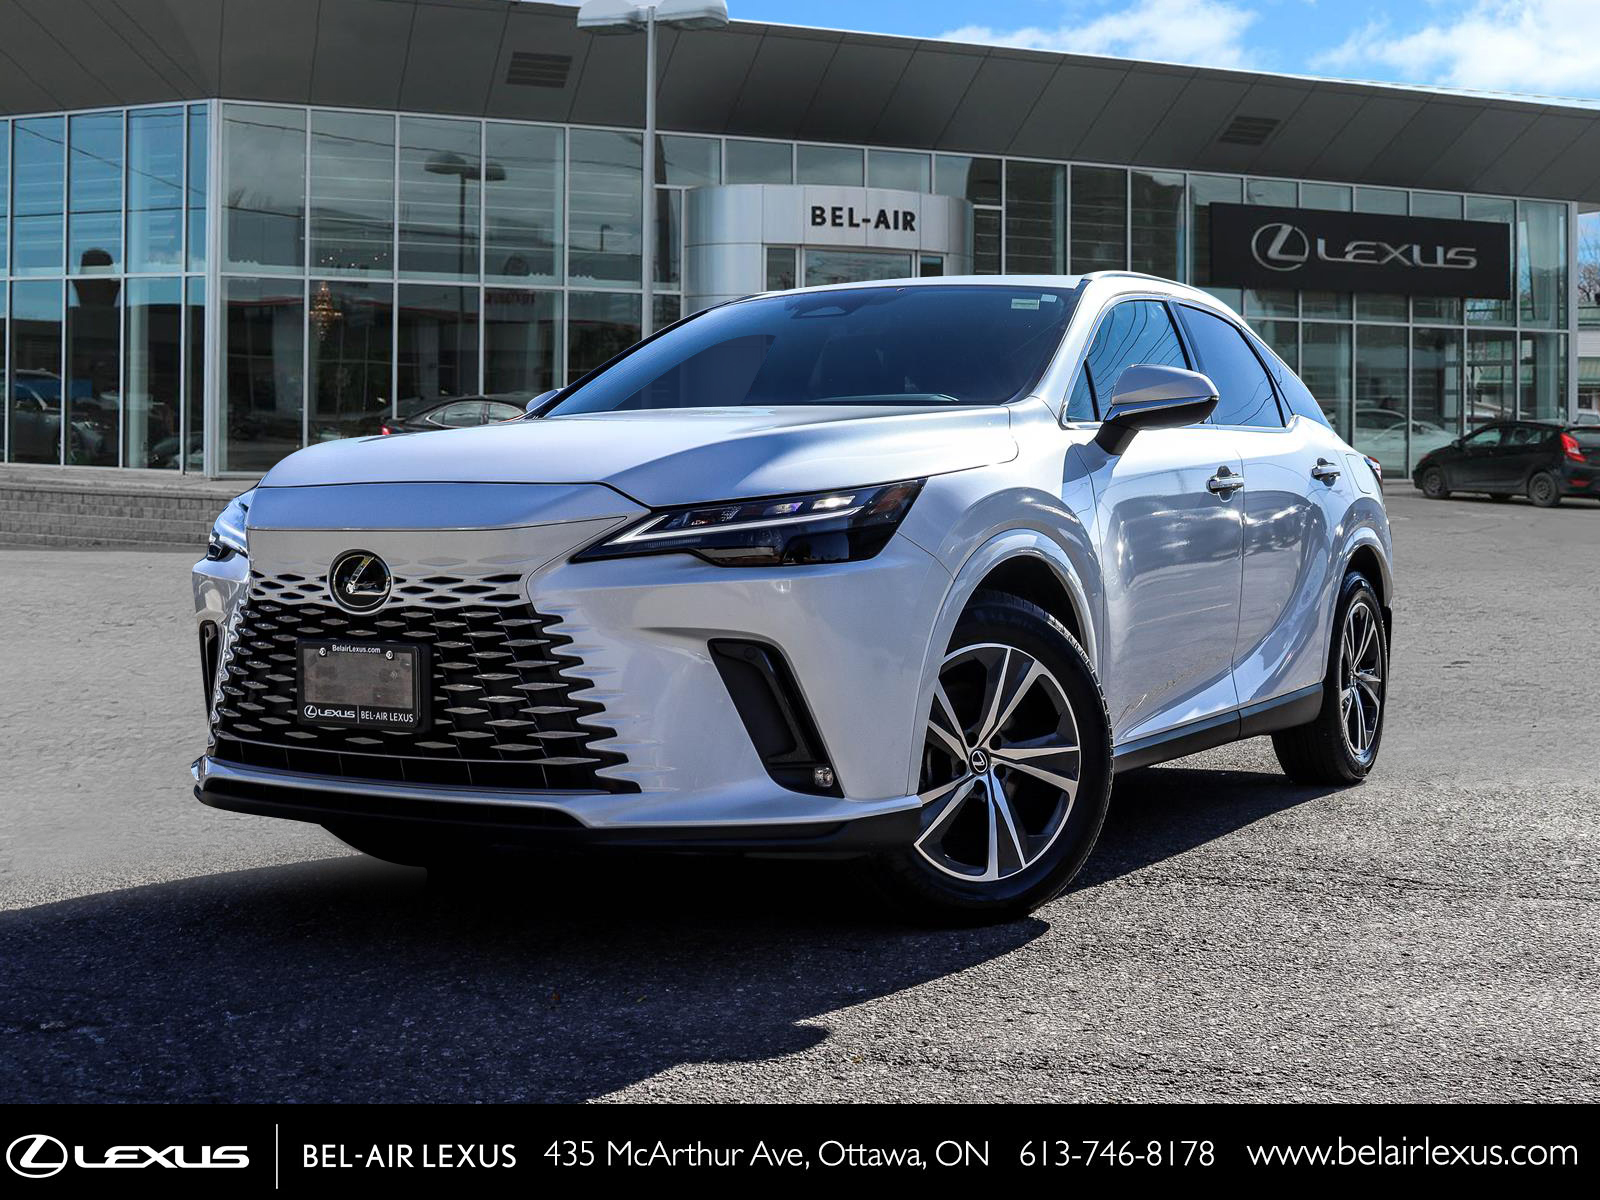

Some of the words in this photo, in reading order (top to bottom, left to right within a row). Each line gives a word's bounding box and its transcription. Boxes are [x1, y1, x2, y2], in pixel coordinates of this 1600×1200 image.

[811, 206, 916, 231] BEL-AIR
[1317, 237, 1478, 269] LEXUS
[332, 644, 381, 654] BelairLexus.com
[318, 708, 355, 719] LEXUS
[389, 712, 414, 723] LEXUS
